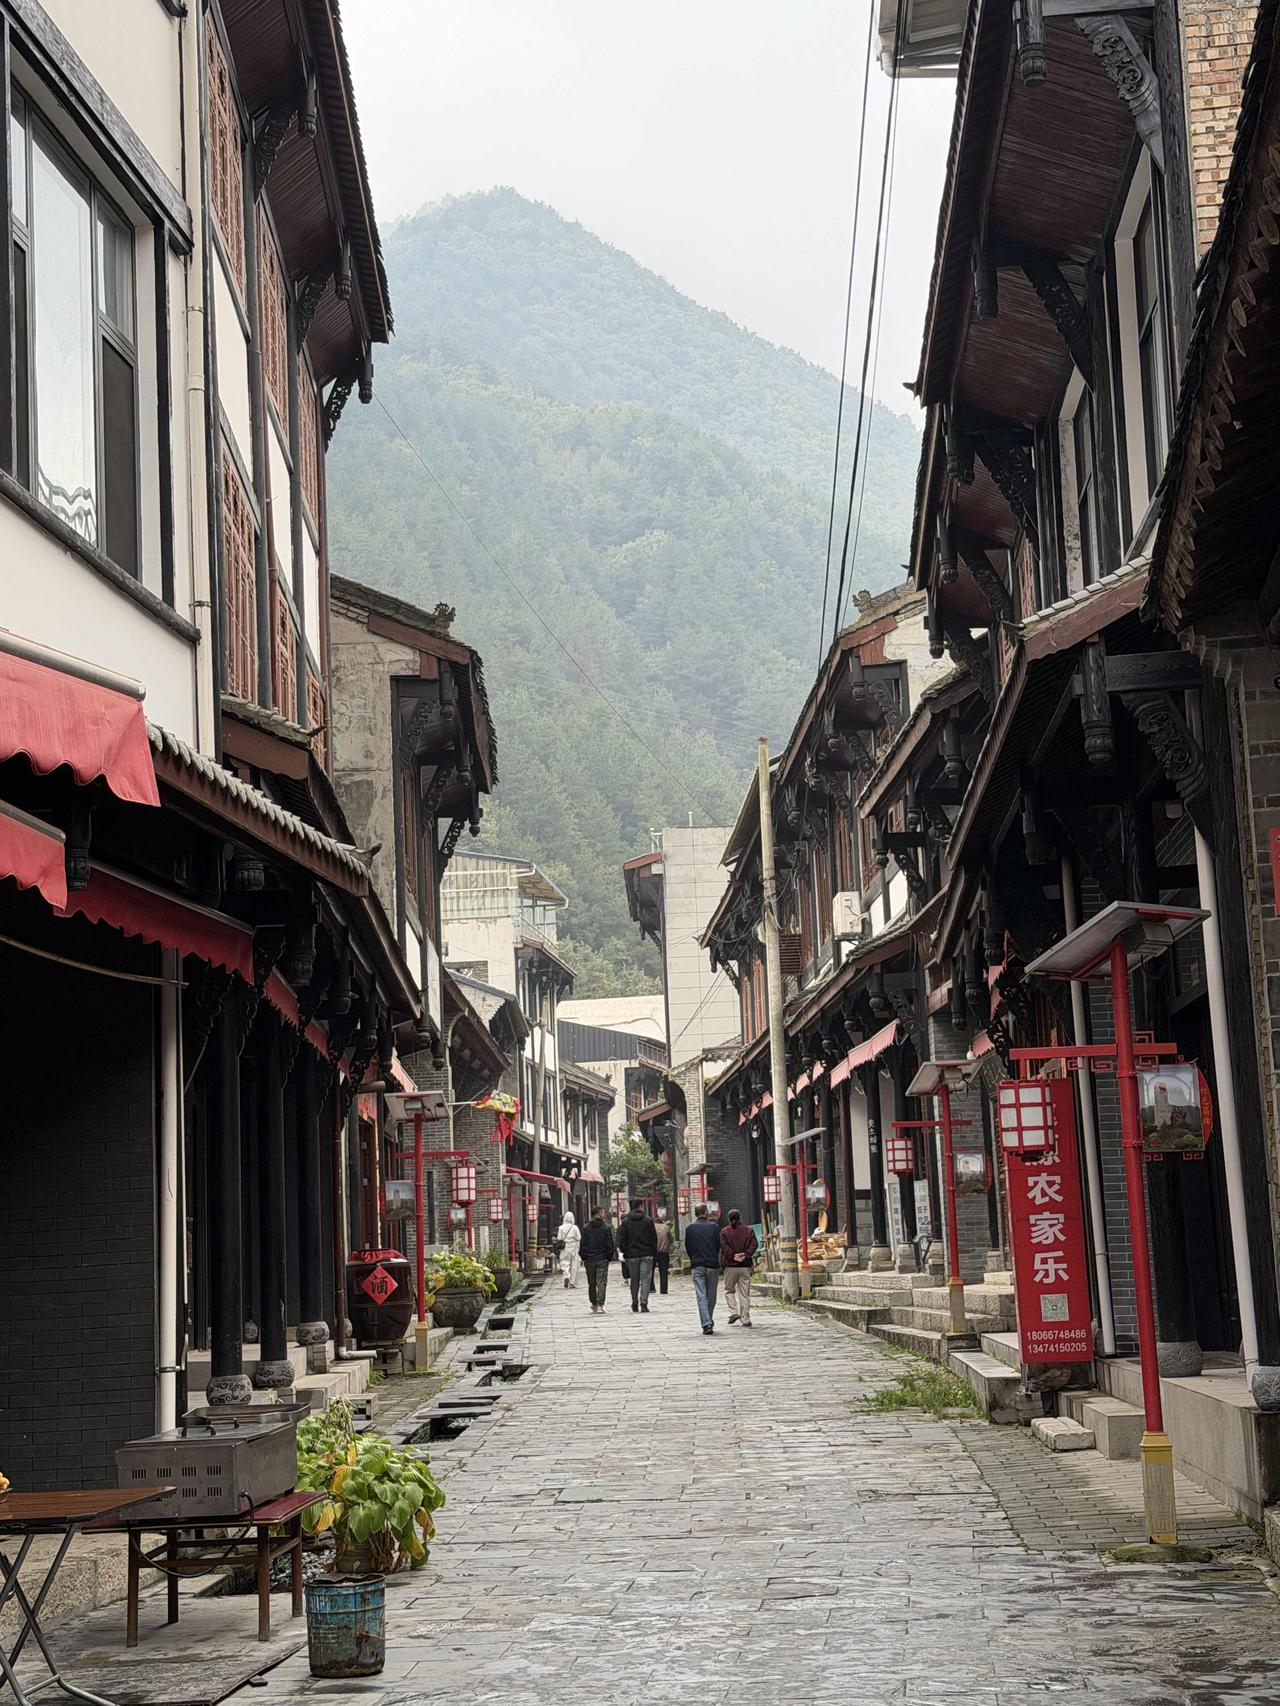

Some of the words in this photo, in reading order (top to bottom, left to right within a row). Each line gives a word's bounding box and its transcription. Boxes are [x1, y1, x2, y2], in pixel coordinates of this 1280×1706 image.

[370, 1275, 388, 1296] 酒
[1026, 1329, 1087, 1341] 18066748486
[1027, 1342, 1088, 1354] 13474150205
